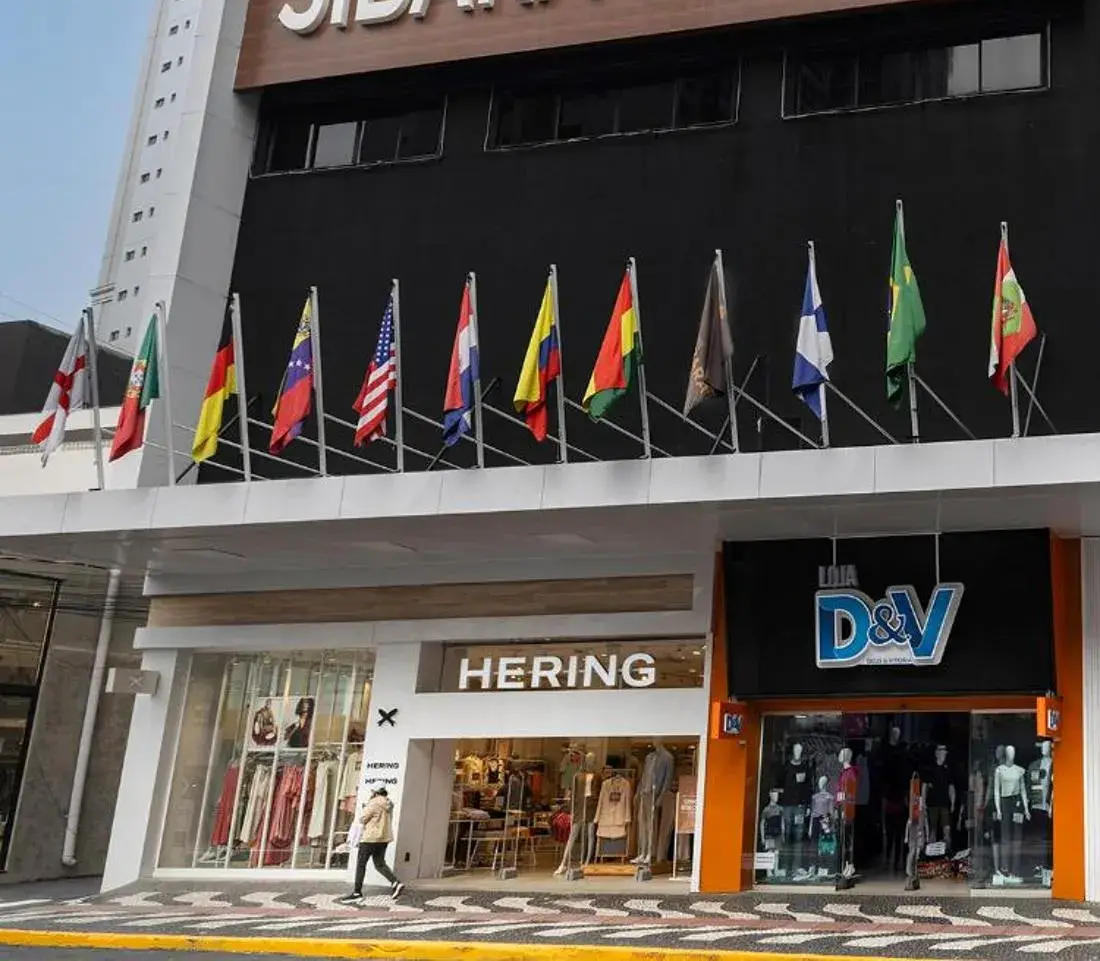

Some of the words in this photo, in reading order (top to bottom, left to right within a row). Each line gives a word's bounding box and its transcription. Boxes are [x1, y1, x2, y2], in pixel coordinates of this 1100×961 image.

[818, 564, 859, 587] LOJA
[815, 583, 963, 667] D&V
[458, 652, 656, 690] HERING
